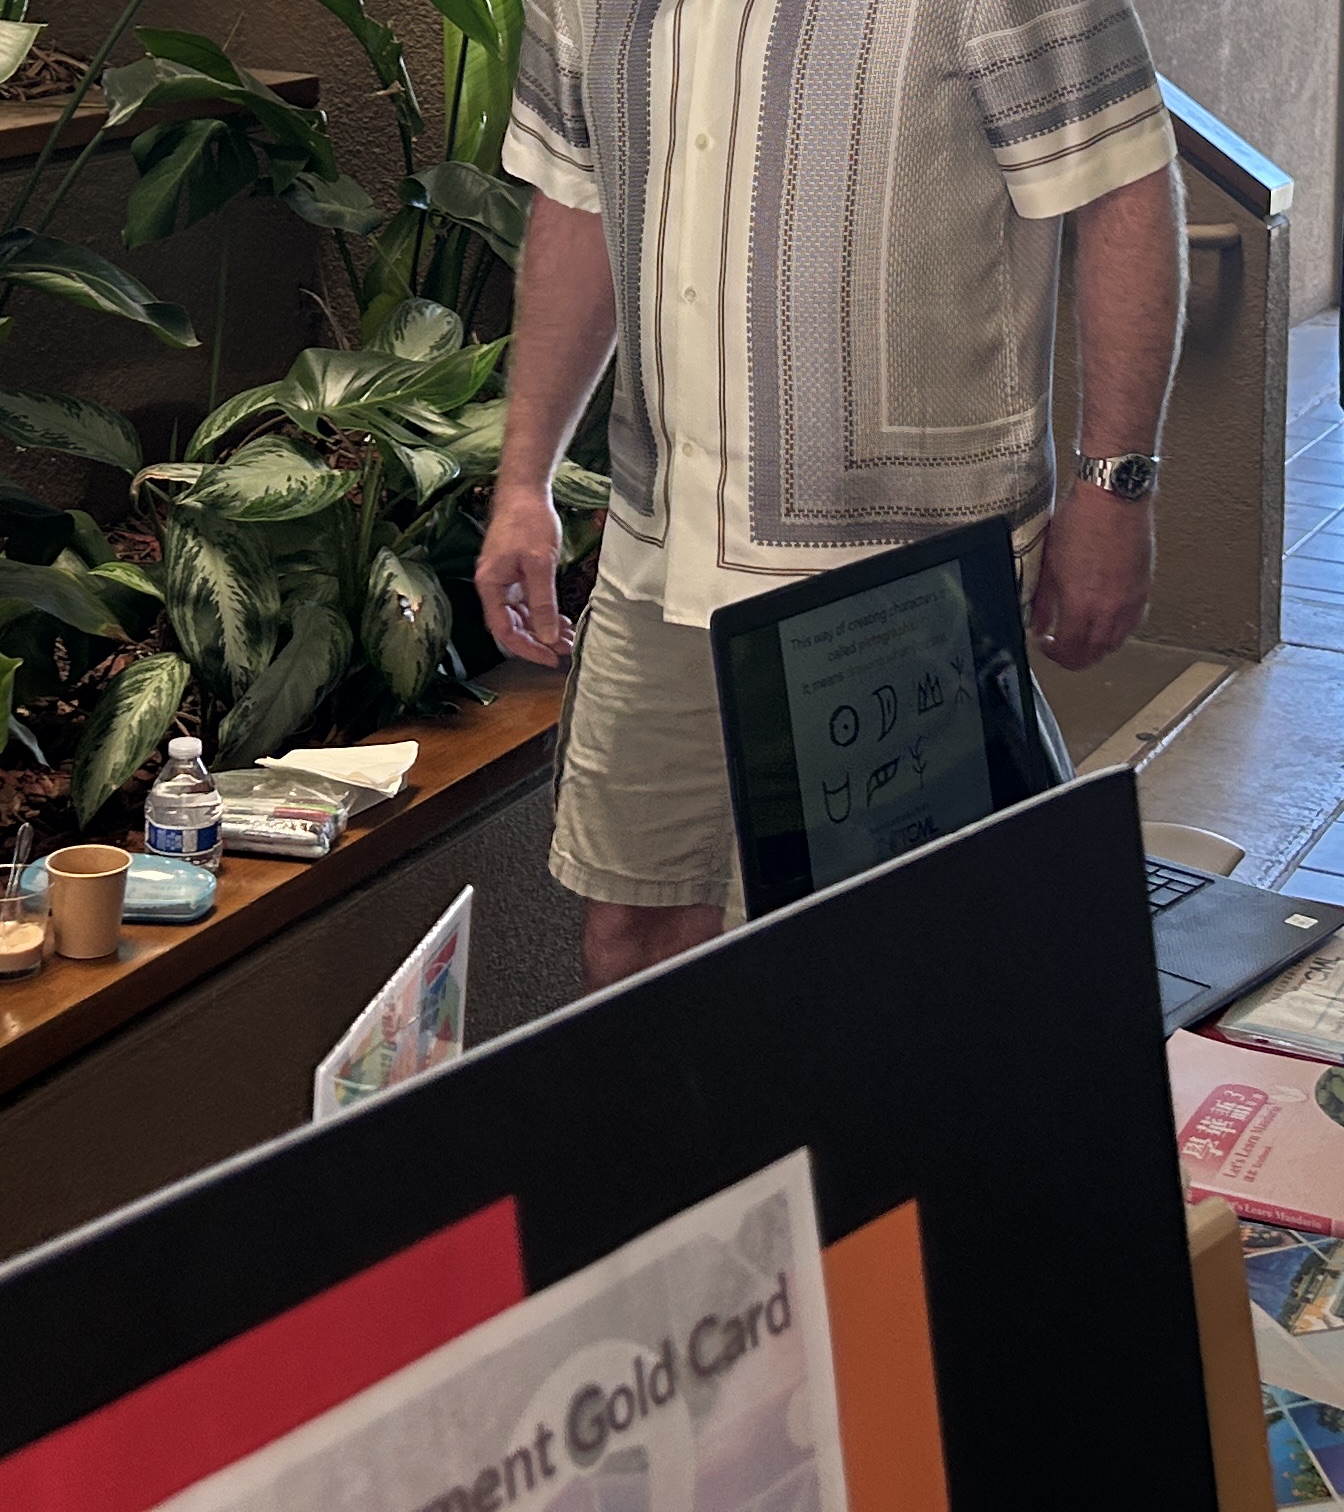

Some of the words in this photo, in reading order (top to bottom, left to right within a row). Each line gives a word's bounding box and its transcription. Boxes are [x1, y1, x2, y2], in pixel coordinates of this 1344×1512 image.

[1235, 1135, 1260, 1158] Learn
[566, 1336, 678, 1453] Gold
[687, 1272, 792, 1378] Card
